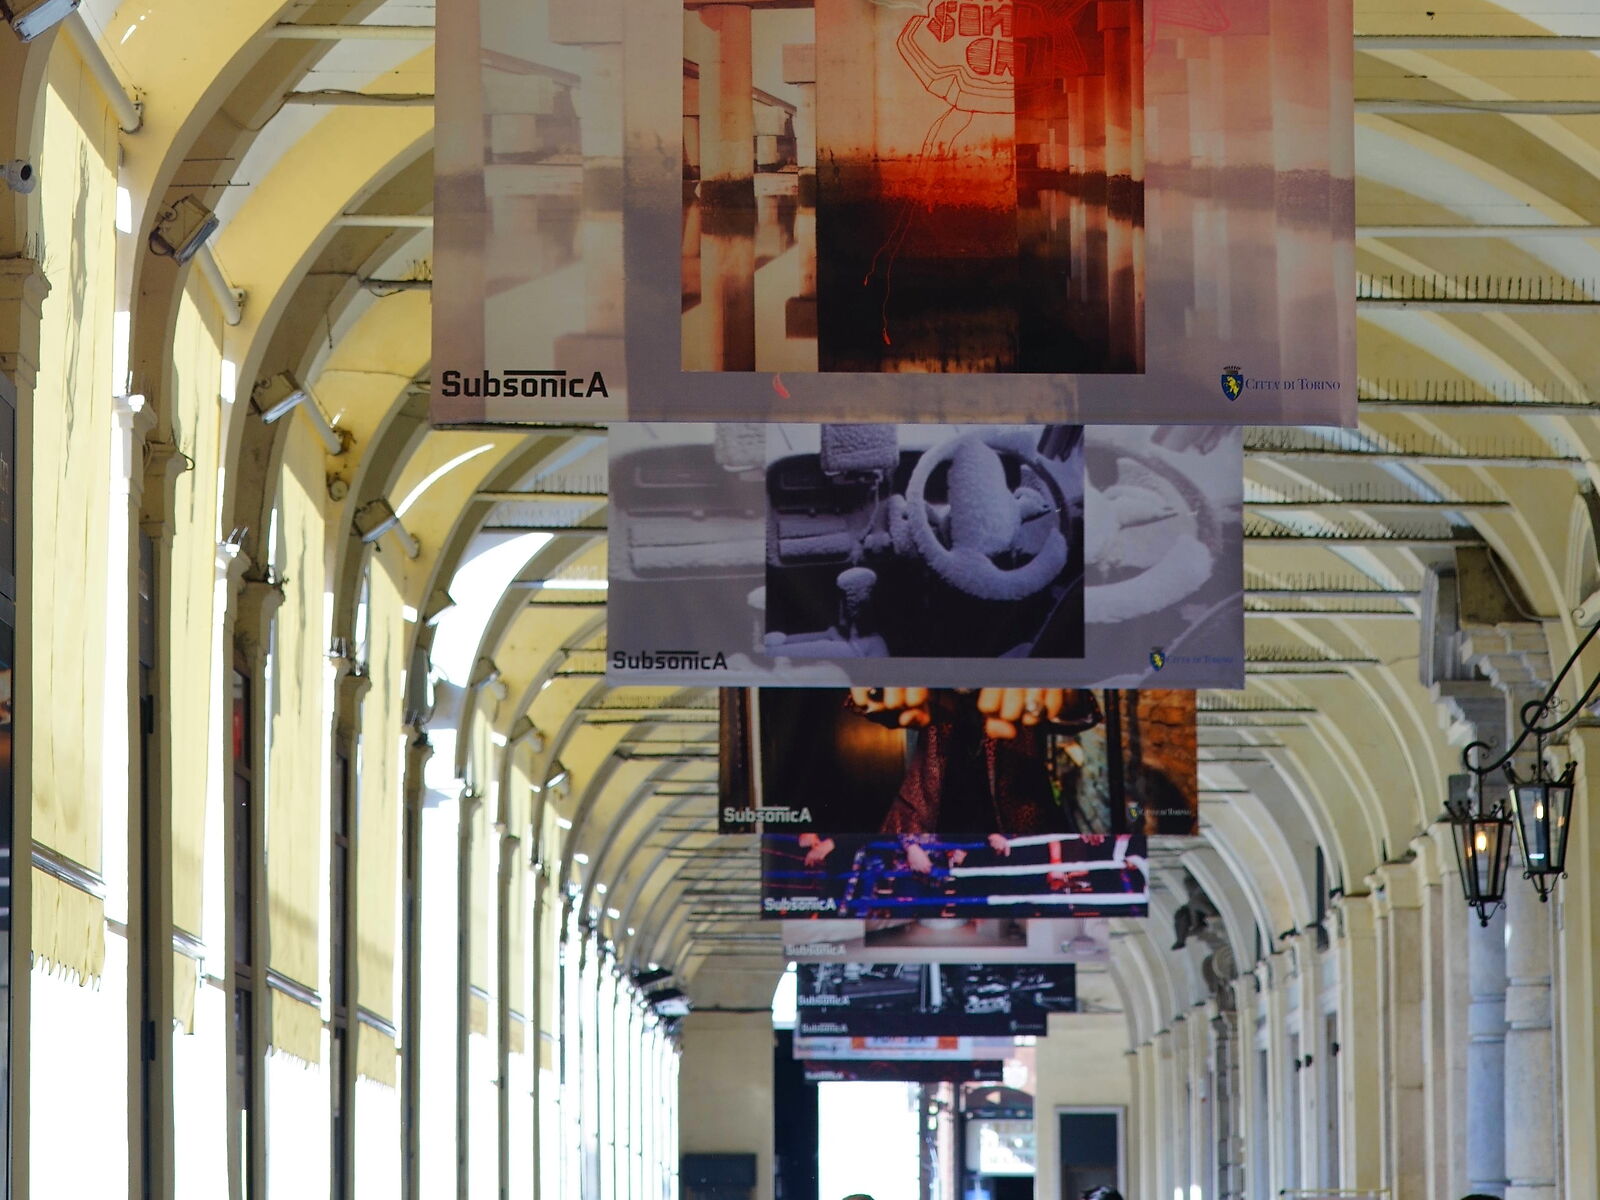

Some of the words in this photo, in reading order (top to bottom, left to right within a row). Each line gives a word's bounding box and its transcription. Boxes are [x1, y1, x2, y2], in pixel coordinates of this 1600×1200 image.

[442, 370, 609, 398] SubsonicA
[613, 650, 728, 670] SubsonicA
[724, 806, 812, 823] SubsonicA
